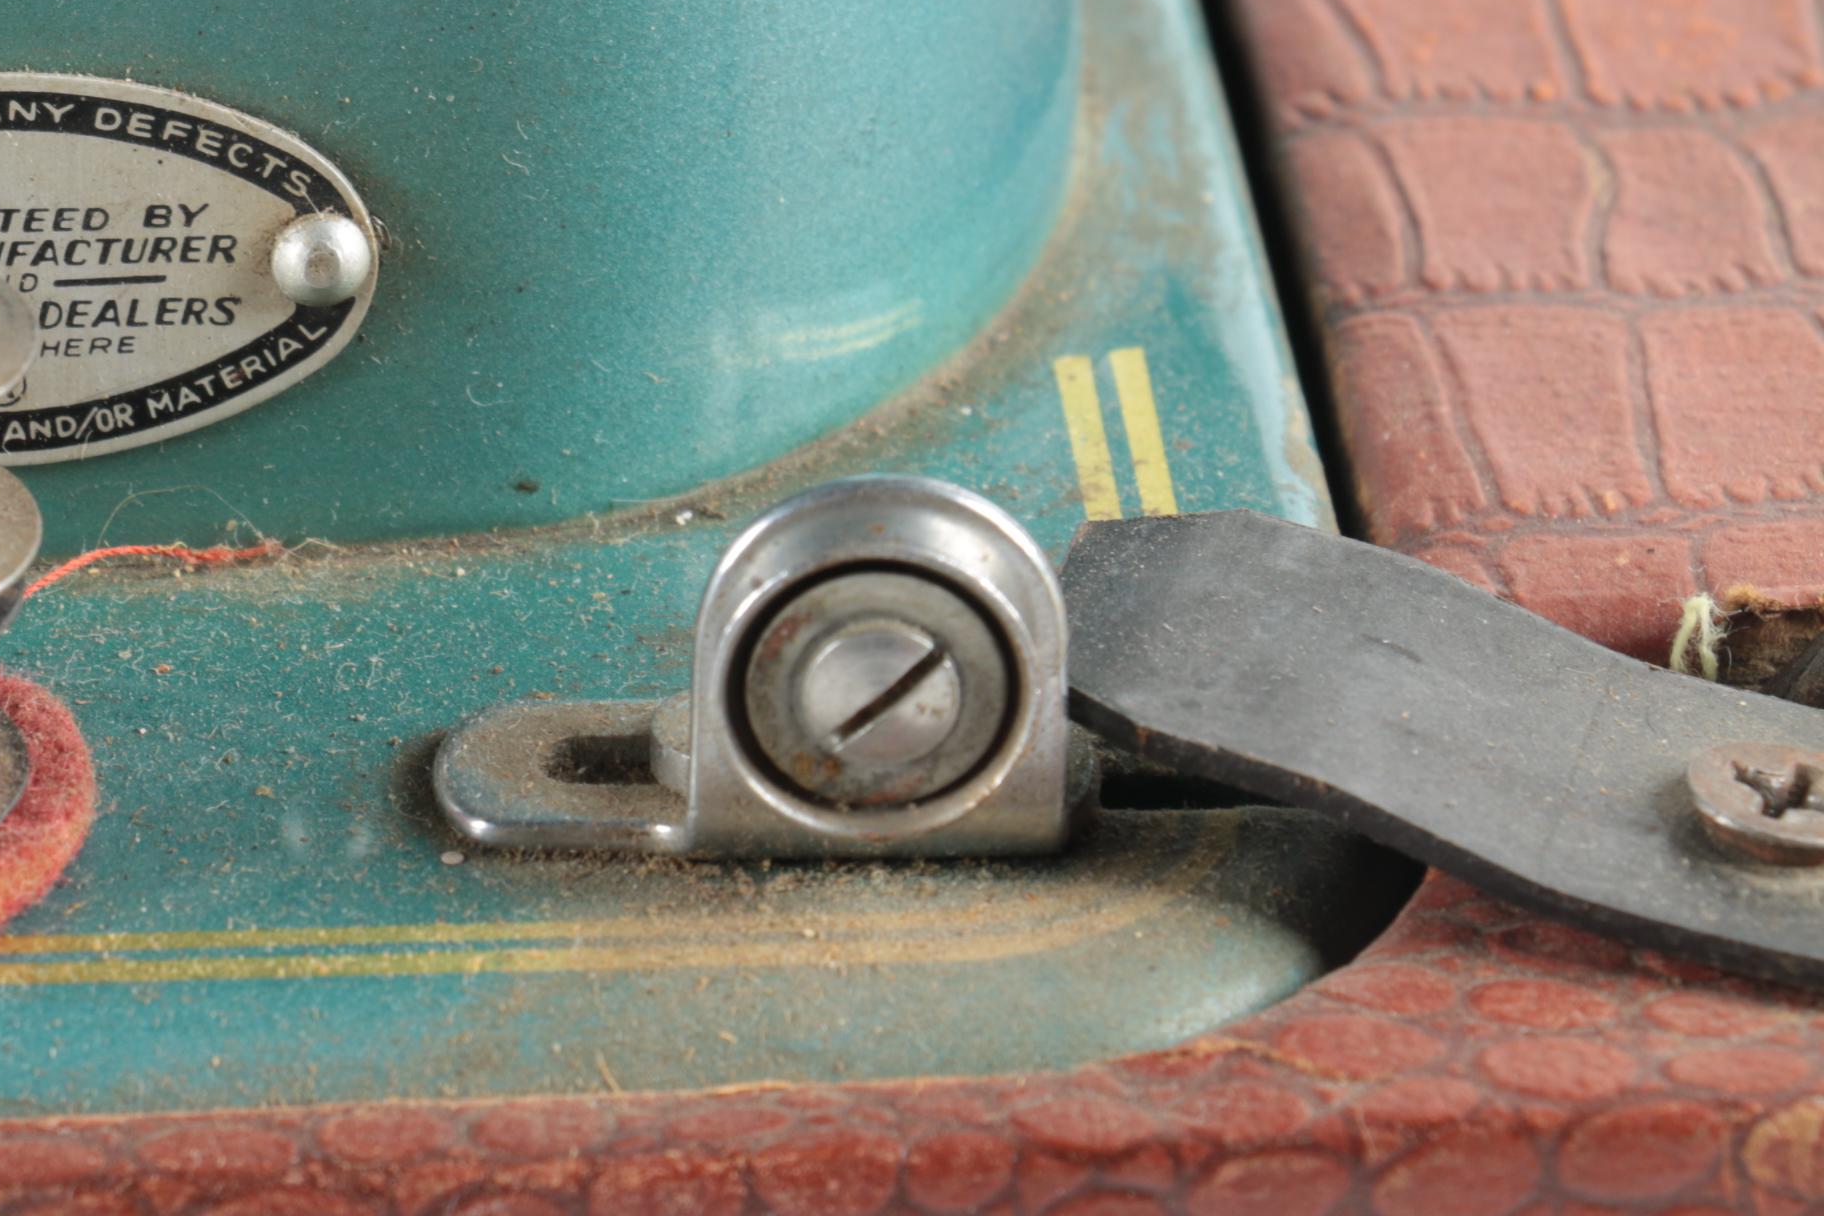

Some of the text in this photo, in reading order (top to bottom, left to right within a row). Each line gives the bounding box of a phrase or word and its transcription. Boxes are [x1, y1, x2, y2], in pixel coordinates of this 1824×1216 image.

[94, 108, 312, 197] DEFECTS
[143, 203, 209, 228] BY
[39, 297, 241, 329] DEALERS
[40, 336, 136, 358] HERE
[2, 322, 327, 444] AND/OR MATERIAL
